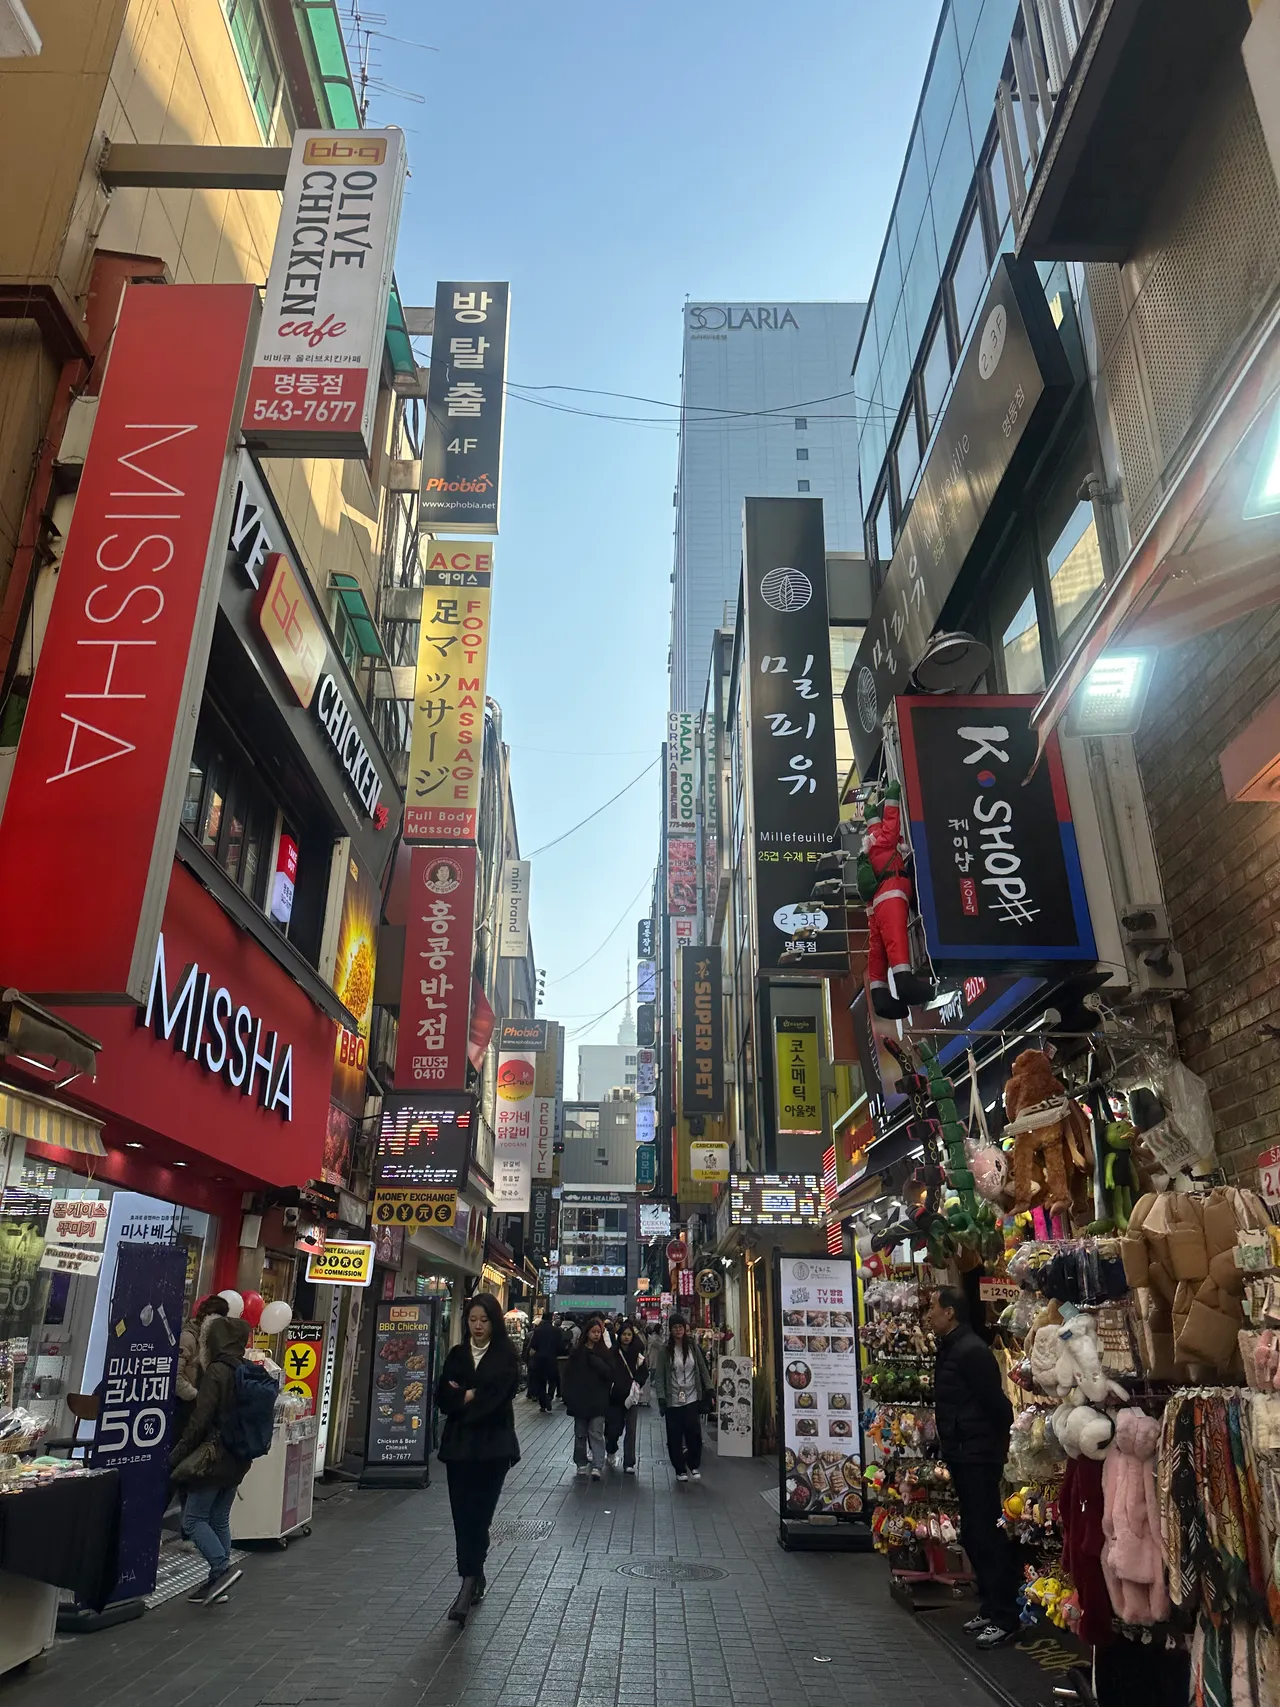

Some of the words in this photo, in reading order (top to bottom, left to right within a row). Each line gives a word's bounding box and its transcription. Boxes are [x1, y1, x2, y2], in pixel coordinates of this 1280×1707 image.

[330, 170, 378, 269] OLIVE
[279, 170, 337, 316] CHICKEN
[278, 313, 347, 347] cafe
[689, 306, 800, 330] SOLARIA
[263, 353, 292, 364] 비비큐
[444, 291, 493, 418] 방탈출
[274, 373, 344, 396] 명동점
[253, 400, 357, 423] 543-7677
[1001, 383, 1026, 439] 명동점
[446, 438, 478, 454] 4F
[426, 476, 488, 494] Phobia
[422, 499, 496, 511] www.xphobia.net
[428, 552, 490, 571] ACE
[437, 572, 478, 585] 에이스
[46, 424, 199, 784] MISSHA
[461, 601, 484, 664] FOOT
[415, 598, 462, 797] 足マッサージ
[760, 654, 820, 796] 밀피유
[317, 673, 384, 820] CHICKEN
[452, 677, 480, 800] MASSAGE
[669, 713, 679, 771] GURKHA
[680, 713, 692, 765] HALAL
[956, 725, 1010, 765] K
[680, 773, 693, 820] FOOD
[407, 811, 433, 821] Full
[438, 811, 473, 824] Body
[407, 824, 470, 837] Massage
[760, 831, 834, 843] Millefeuille
[758, 852, 780, 863] 25겹
[783, 852, 804, 863] 수제
[948, 818, 975, 873] 케이샵
[510, 867, 522, 895] mini
[508, 896, 522, 934] brand
[417, 899, 457, 1051] 홍콩반점
[145, 932, 293, 1122] MISSHA
[694, 981, 710, 1051] SUPER
[503, 1026, 539, 1038] Phobia
[339, 1031, 365, 1072] BBQ
[413, 1068, 445, 1080] 0410
[695, 1058, 712, 1099] PET
[790, 1040, 806, 1102] 코스메틱
[499, 1110, 531, 1123] 유가네
[784, 1105, 816, 1118] 아울렛
[498, 1126, 530, 1139] 닭갈비
[377, 1192, 409, 1201] MONEY
[410, 1192, 456, 1202] EXCHANGE
[56, 1221, 97, 1237] 꾸미기
[120, 1224, 149, 1240] 미샤
[44, 1248, 76, 1261] Phone
[76, 1252, 100, 1263] Case
[337, 1247, 366, 1256] EXCHANGE
[56, 1260, 82, 1271] DIY
[324, 1269, 363, 1277] COMMISSION
[379, 1322, 396, 1331] BBQ
[397, 1322, 429, 1331] Chicken
[130, 1343, 154, 1352] 2024
[109, 1356, 140, 1376] 미샤
[142, 1356, 173, 1374] 연말
[105, 1376, 170, 1404] 감사제
[321, 1338, 335, 1427] CHICKEN
[98, 1407, 167, 1453] 50
